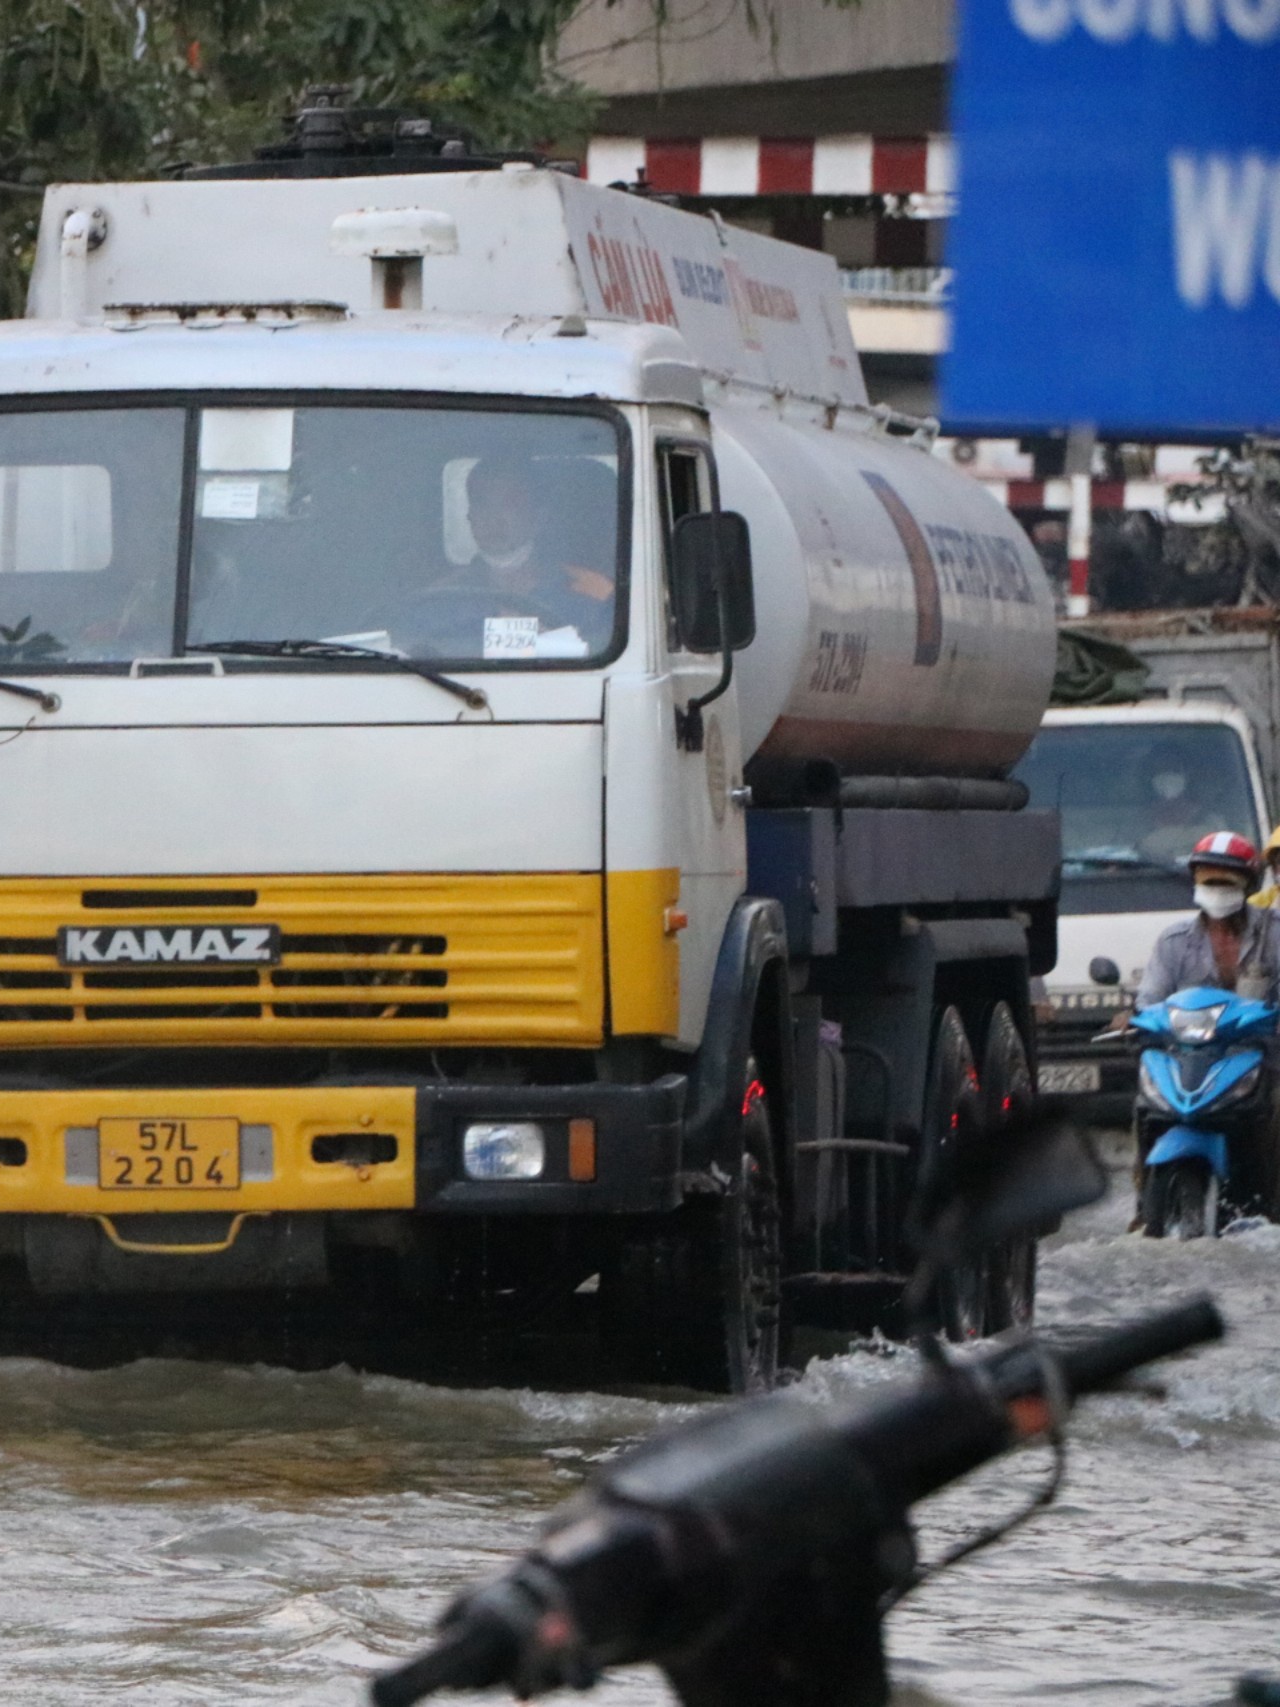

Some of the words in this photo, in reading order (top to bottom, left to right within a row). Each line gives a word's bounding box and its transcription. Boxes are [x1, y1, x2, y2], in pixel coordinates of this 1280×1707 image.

[1169, 147, 1280, 311] W
[66, 928, 270, 962] KAMAZ
[139, 1122, 198, 1151] 57L
[115, 1156, 224, 1186] 2204
